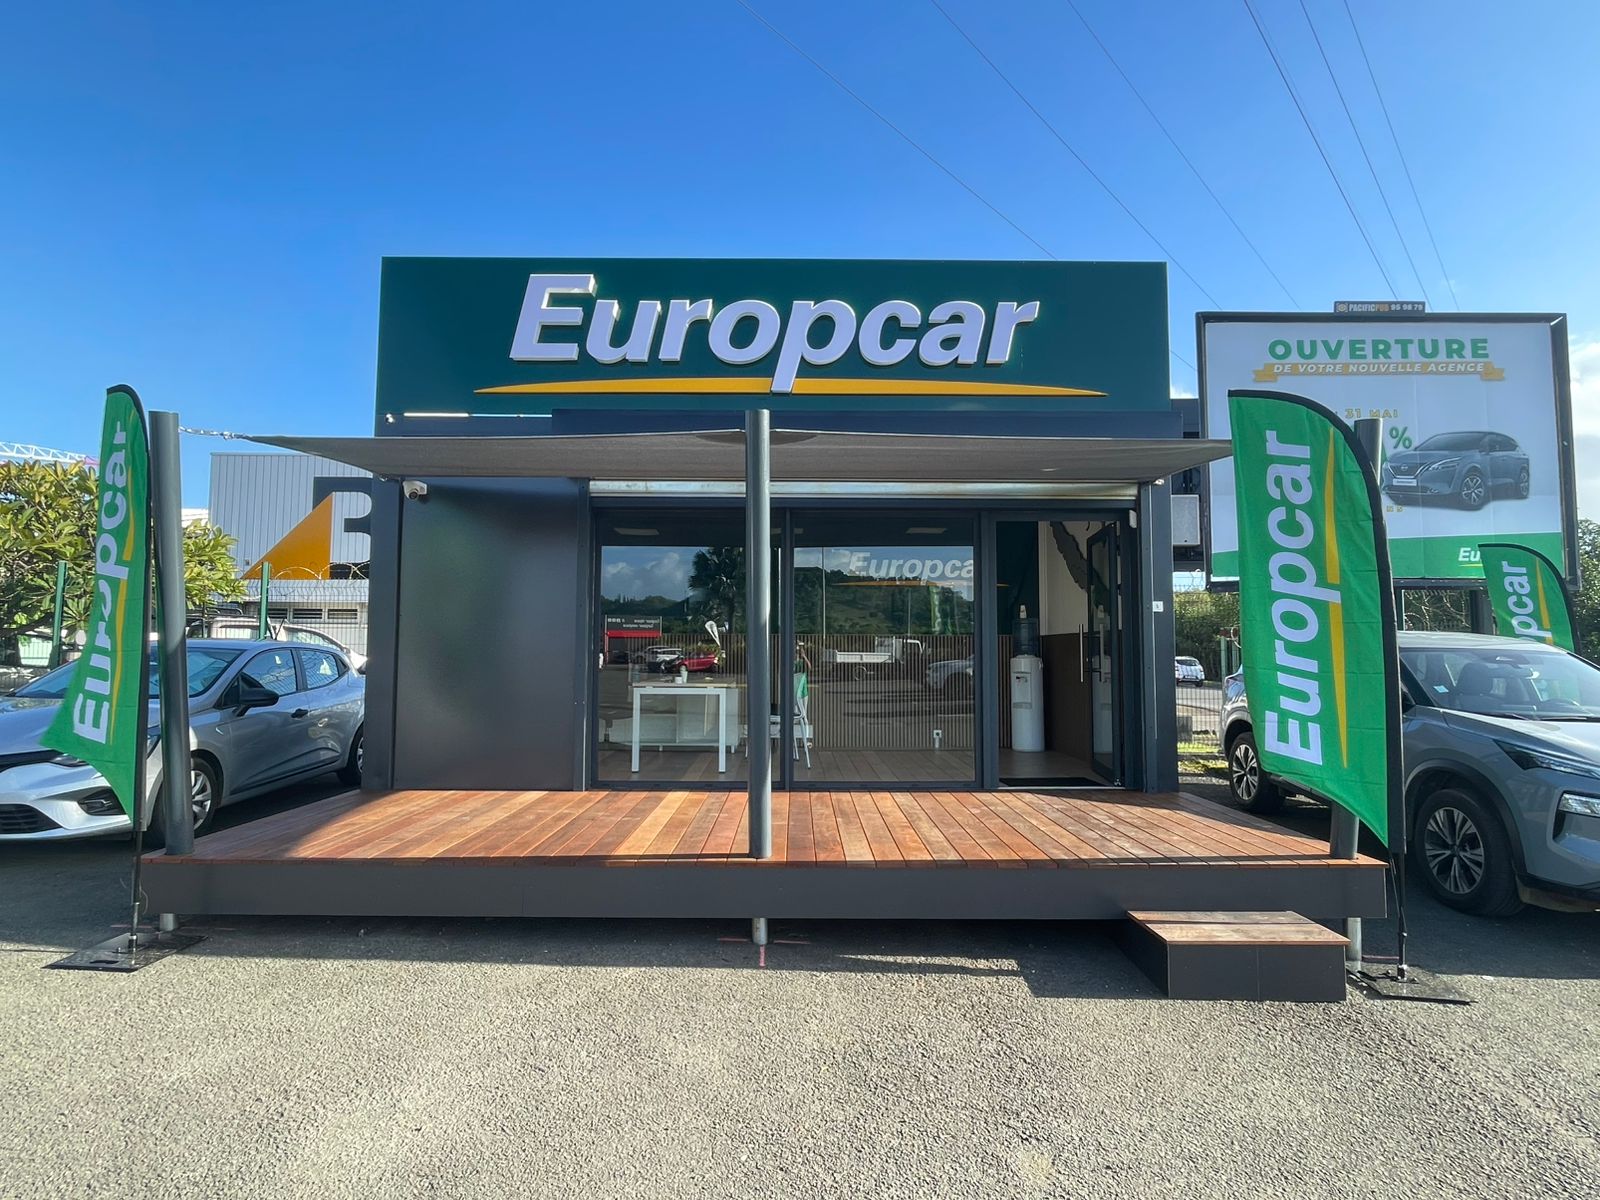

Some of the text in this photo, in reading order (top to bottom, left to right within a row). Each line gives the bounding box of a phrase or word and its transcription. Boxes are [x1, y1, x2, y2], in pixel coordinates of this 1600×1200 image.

[509, 273, 1040, 394] Europcar
[1267, 338, 1490, 361] OUVERTURE
[1273, 362, 1485, 373] DE VOTRE NOUVELLE AGENCE
[1369, 408, 1399, 419] MAI
[1264, 430, 1341, 765] Europcar
[1501, 560, 1553, 641] pcar
